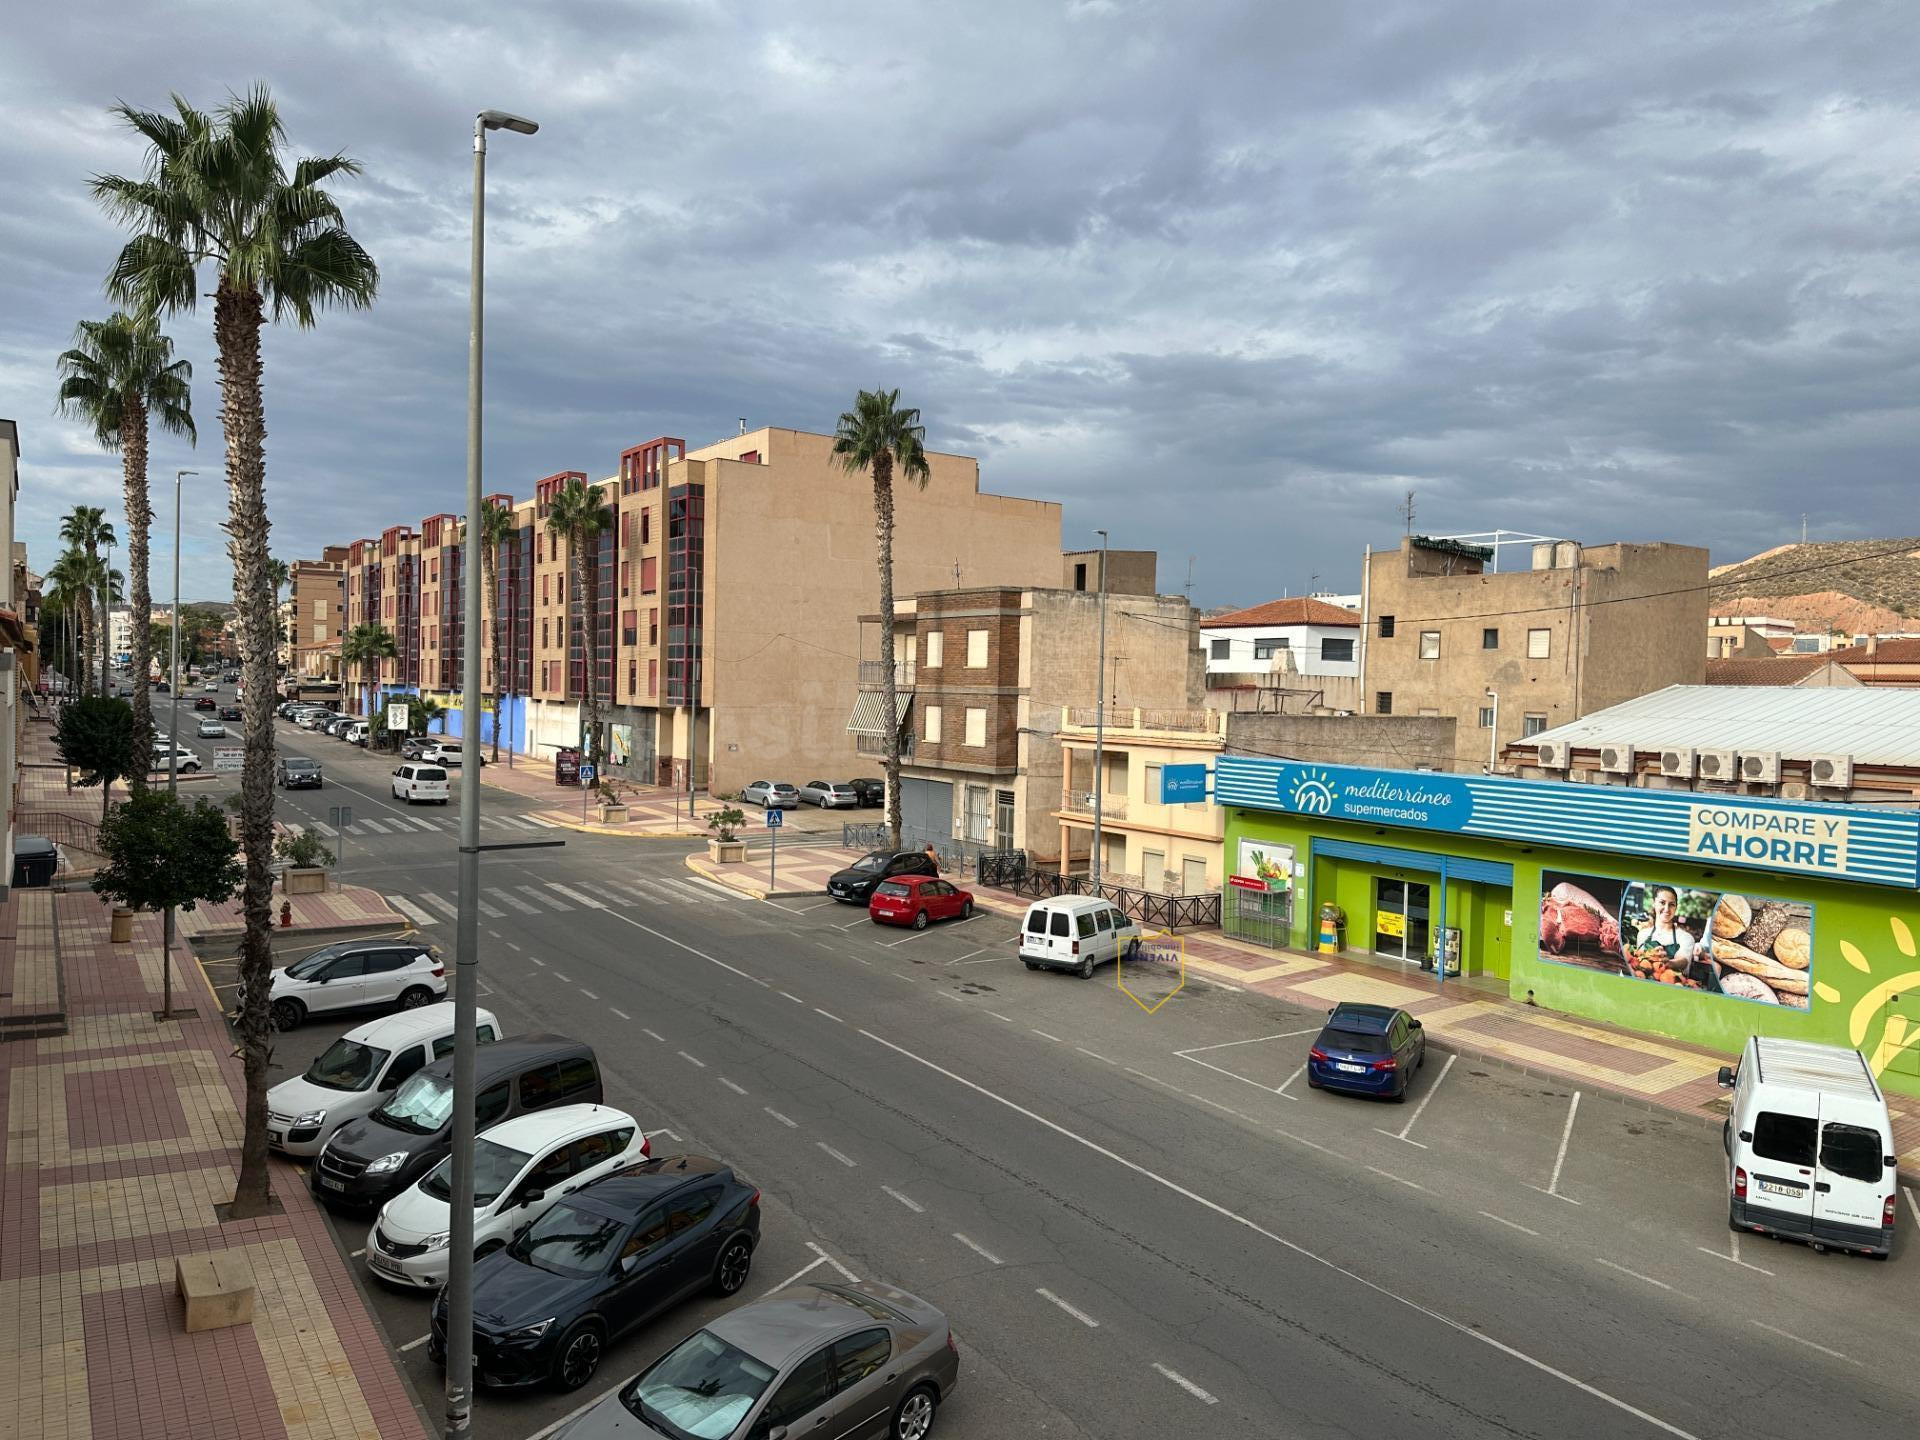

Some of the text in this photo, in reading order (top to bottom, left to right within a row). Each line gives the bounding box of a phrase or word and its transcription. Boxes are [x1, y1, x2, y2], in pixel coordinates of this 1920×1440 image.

[1344, 777, 1453, 806] mediterráneo
[1344, 803, 1428, 822] supermercados
[1698, 809, 1839, 838] COMPARE Y
[1696, 831, 1838, 868] AHORRE
